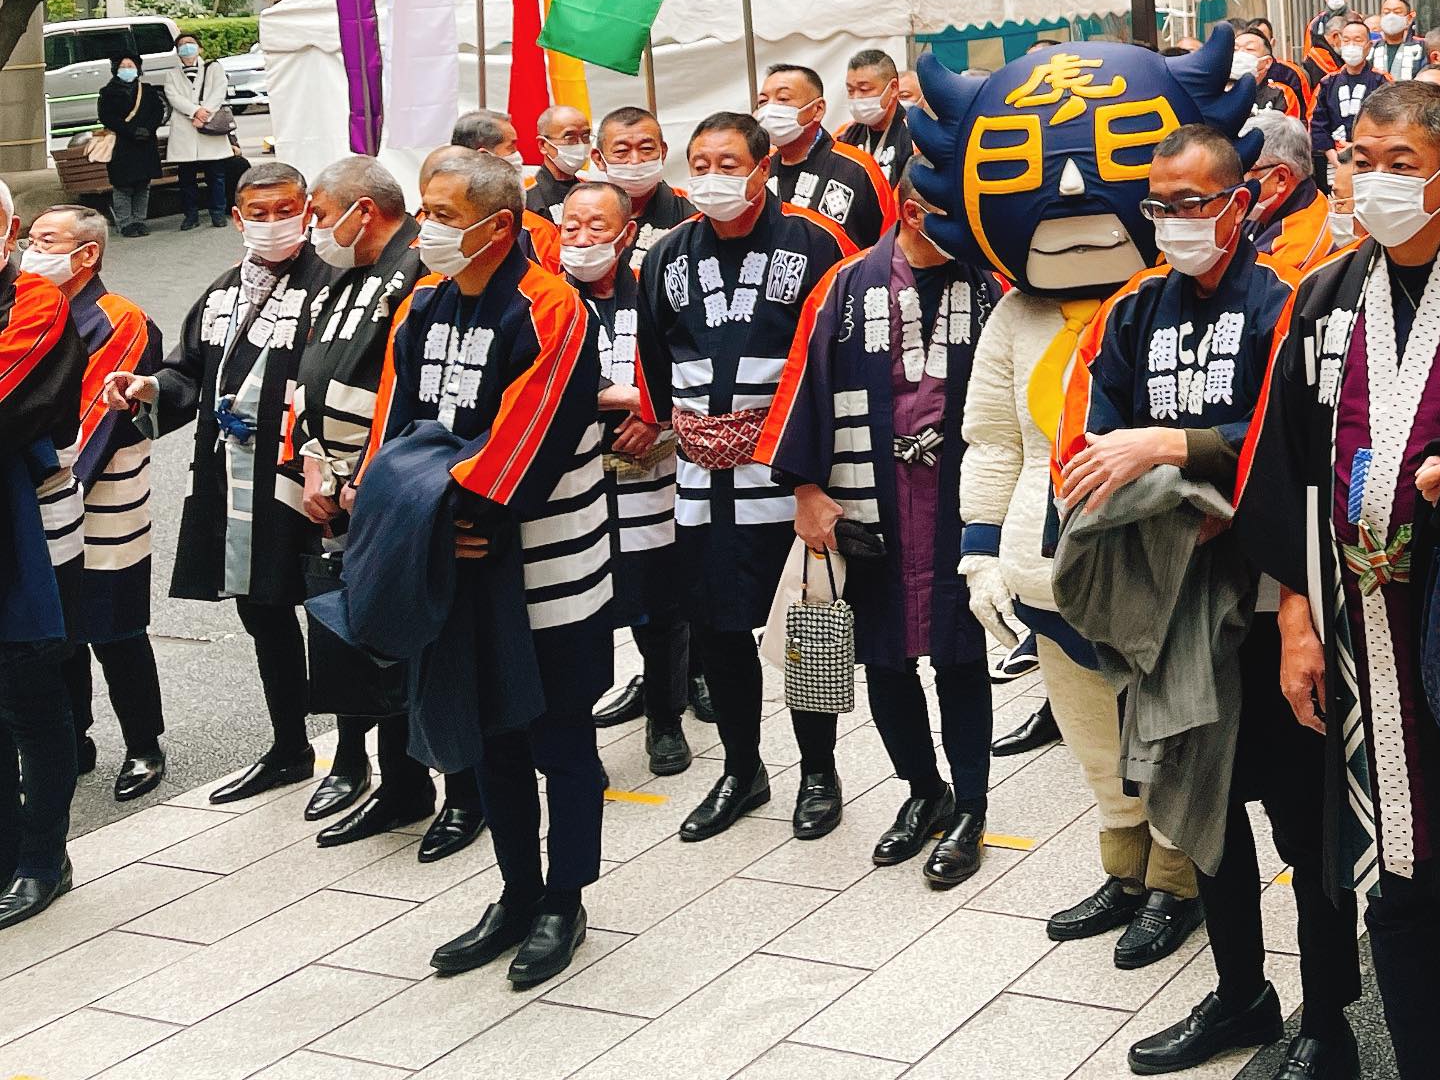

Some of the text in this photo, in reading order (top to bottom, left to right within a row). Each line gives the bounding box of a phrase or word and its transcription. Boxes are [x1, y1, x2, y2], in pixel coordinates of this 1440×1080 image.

[1004, 53, 1127, 126] 虎
[697, 256, 727, 328] 組頭
[725, 251, 768, 323] 組頭
[864, 286, 890, 353] 組頭
[949, 281, 971, 344] 組頭
[418, 323, 450, 403] 組頭
[459, 327, 494, 409] 組頭
[1147, 326, 1178, 420] 組頭
[1204, 311, 1245, 406] 組頭
[1318, 307, 1353, 407] 組頭
